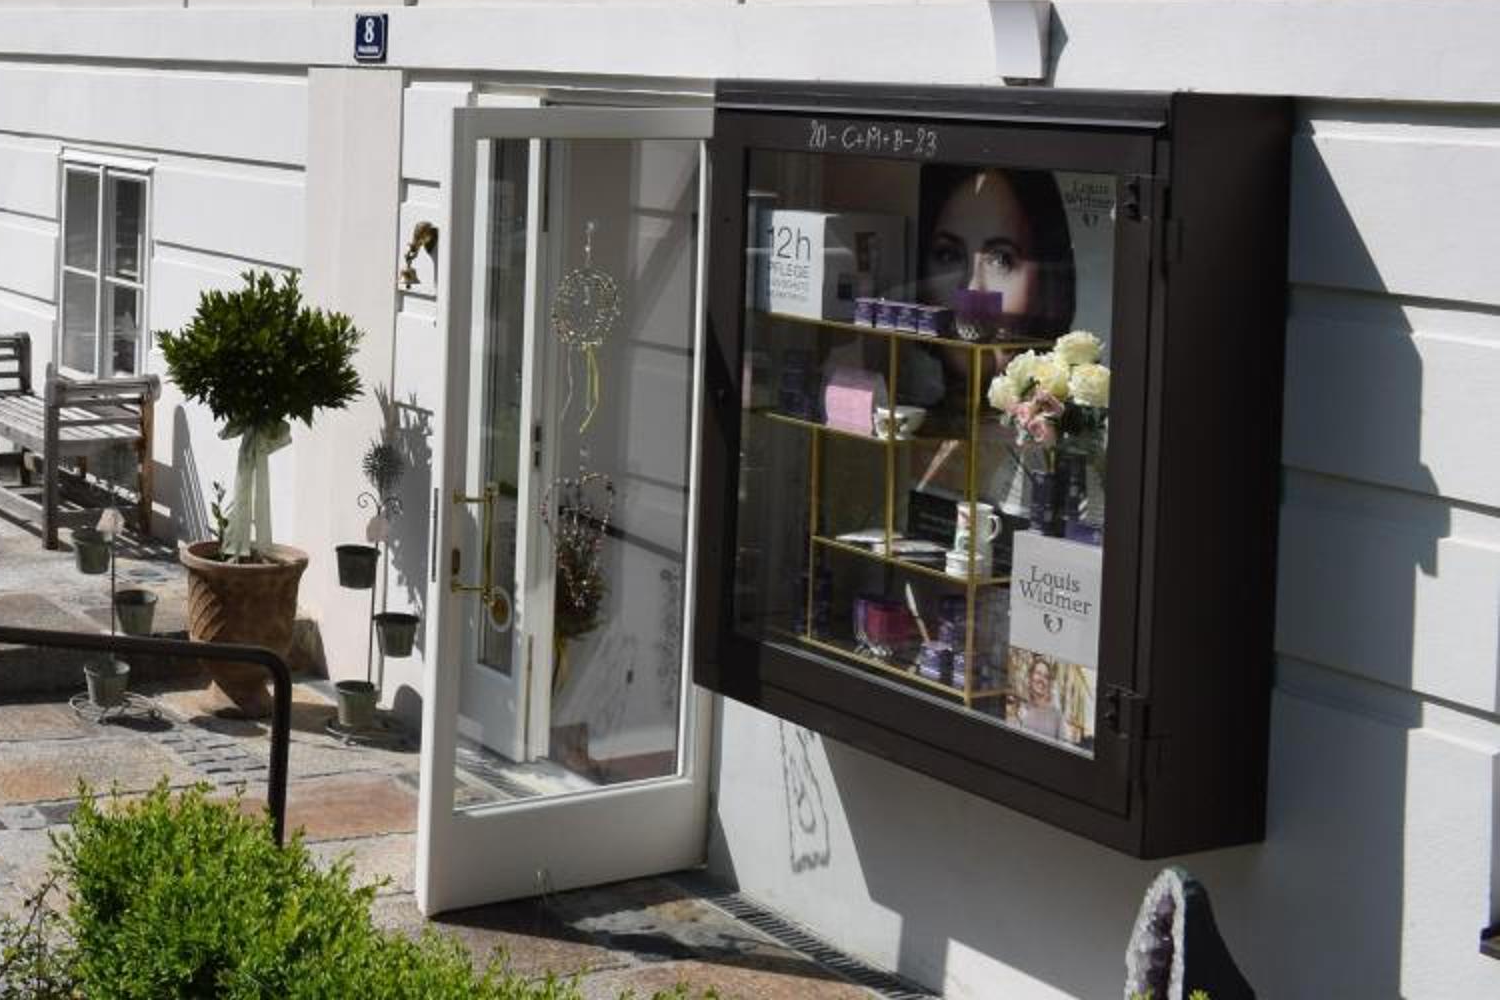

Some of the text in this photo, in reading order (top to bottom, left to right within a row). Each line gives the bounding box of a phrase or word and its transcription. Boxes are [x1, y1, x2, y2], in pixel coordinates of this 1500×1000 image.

[364, 17, 375, 43] 8
[1031, 565, 1080, 593] Louis
[1019, 579, 1093, 615] Widmer
